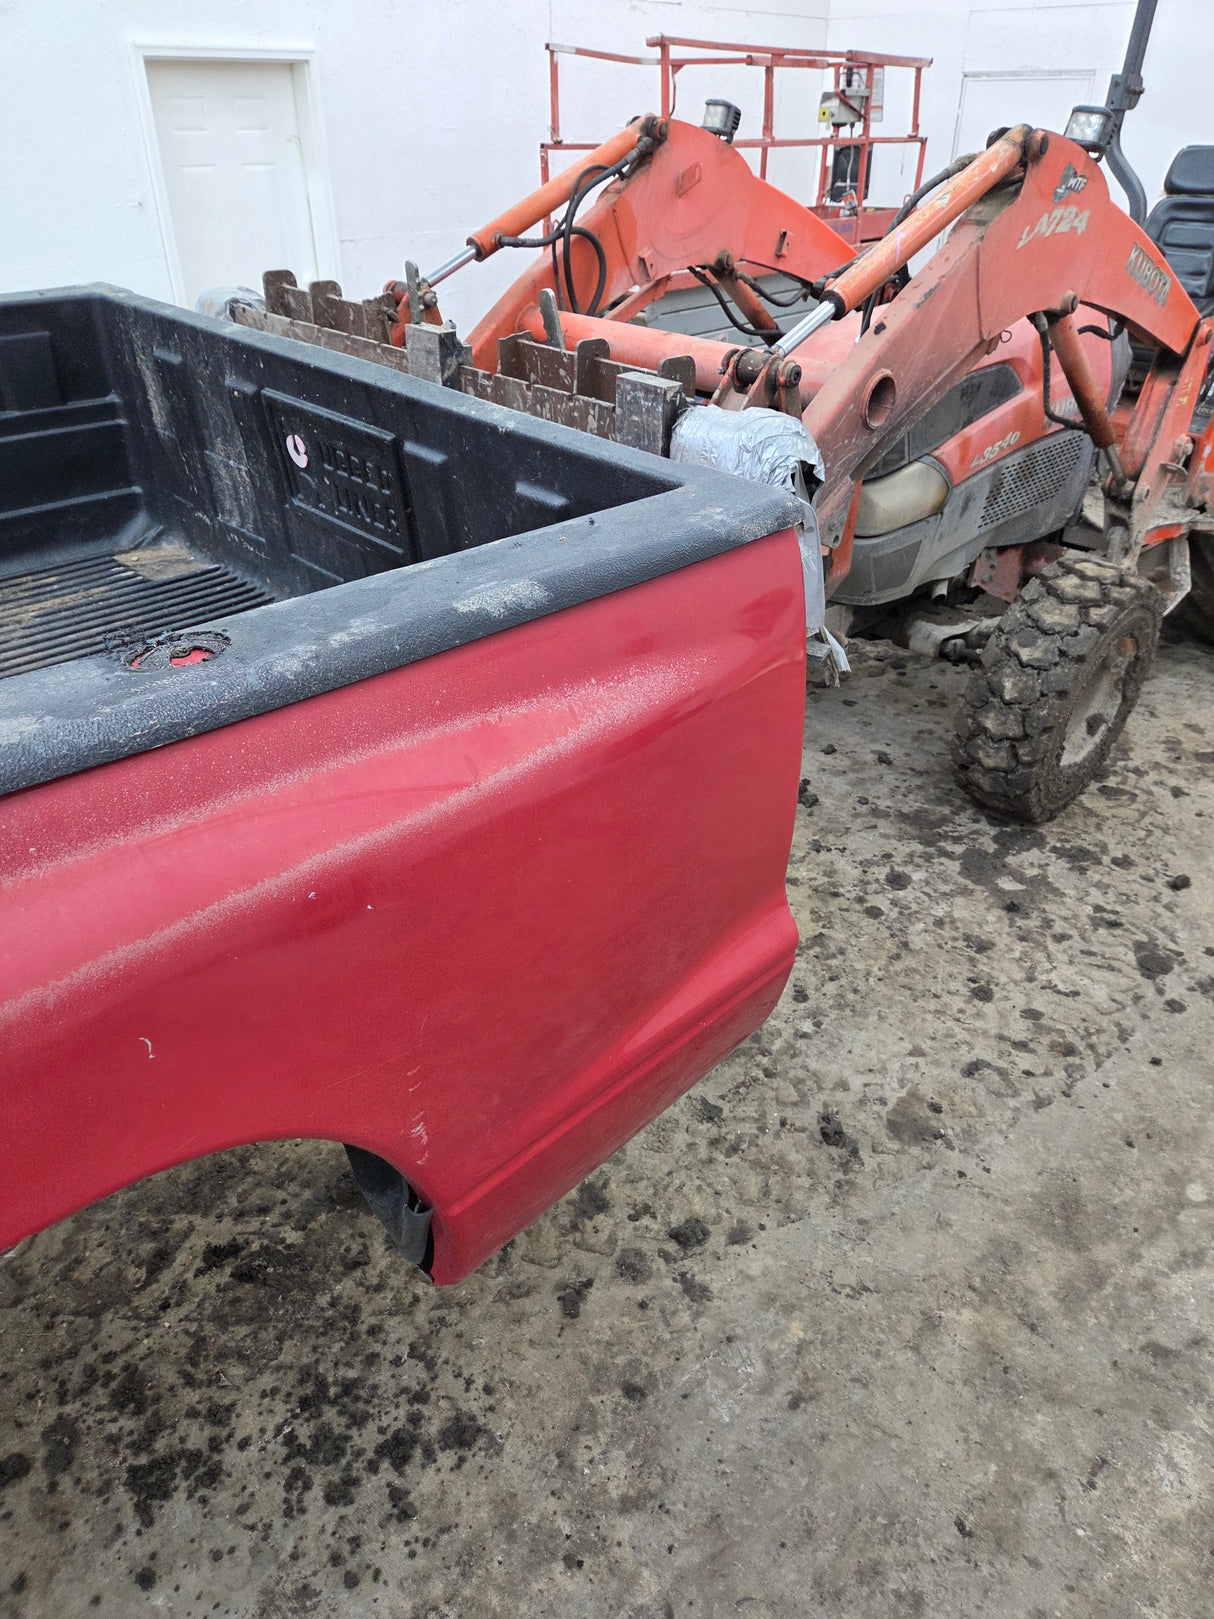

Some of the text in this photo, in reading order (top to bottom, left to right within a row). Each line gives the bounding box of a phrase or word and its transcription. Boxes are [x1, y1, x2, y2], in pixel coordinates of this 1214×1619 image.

[1016, 205, 1090, 249] LA724
[1125, 241, 1171, 307] KUBOTA
[969, 431, 1021, 468] L3540
